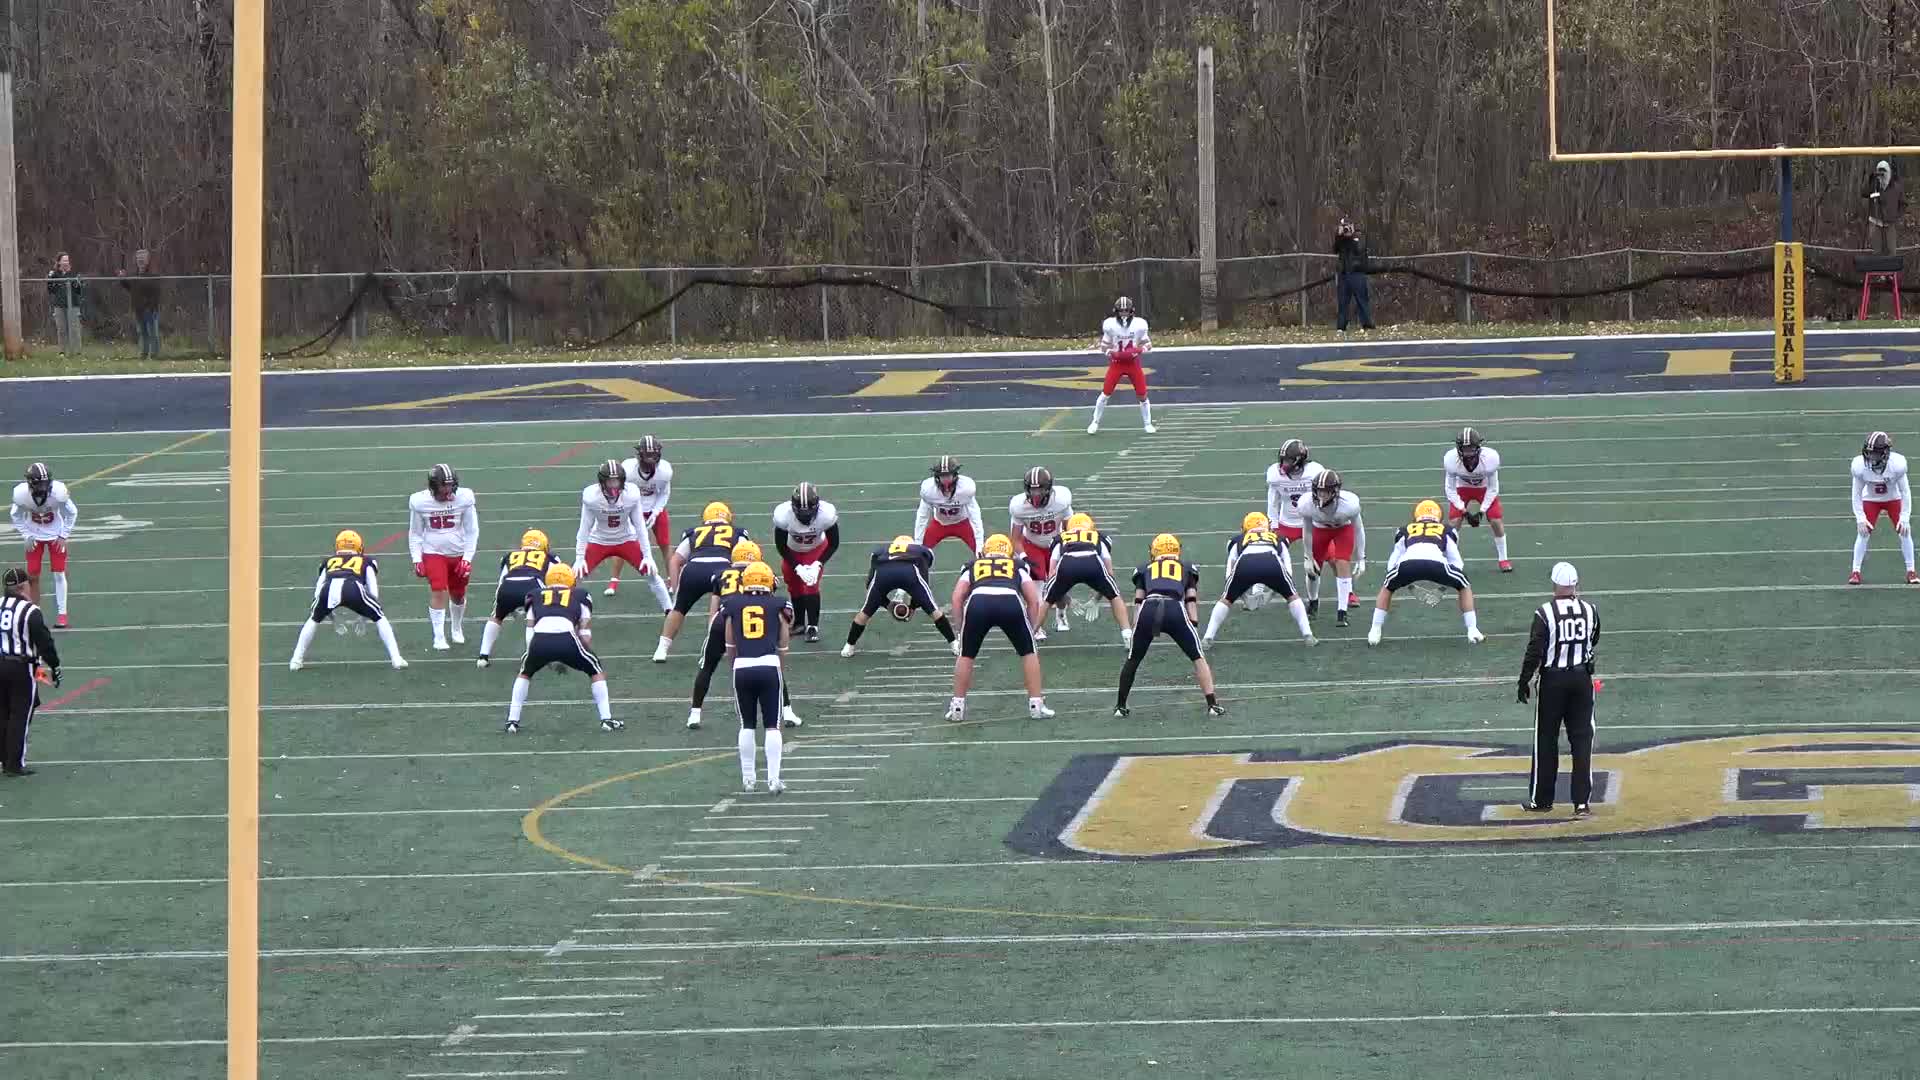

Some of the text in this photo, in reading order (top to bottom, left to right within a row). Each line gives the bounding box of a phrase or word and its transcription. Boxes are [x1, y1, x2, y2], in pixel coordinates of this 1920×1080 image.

[1782, 261, 1795, 368] ARSENAL
[694, 526, 733, 548] 72
[327, 556, 363, 575] 24
[509, 555, 545, 570] 99
[973, 559, 1014, 580] 63
[1149, 559, 1182, 580] 10
[721, 569, 745, 595] 3
[742, 606, 765, 638] 6
[1558, 619, 1586, 641] 103
